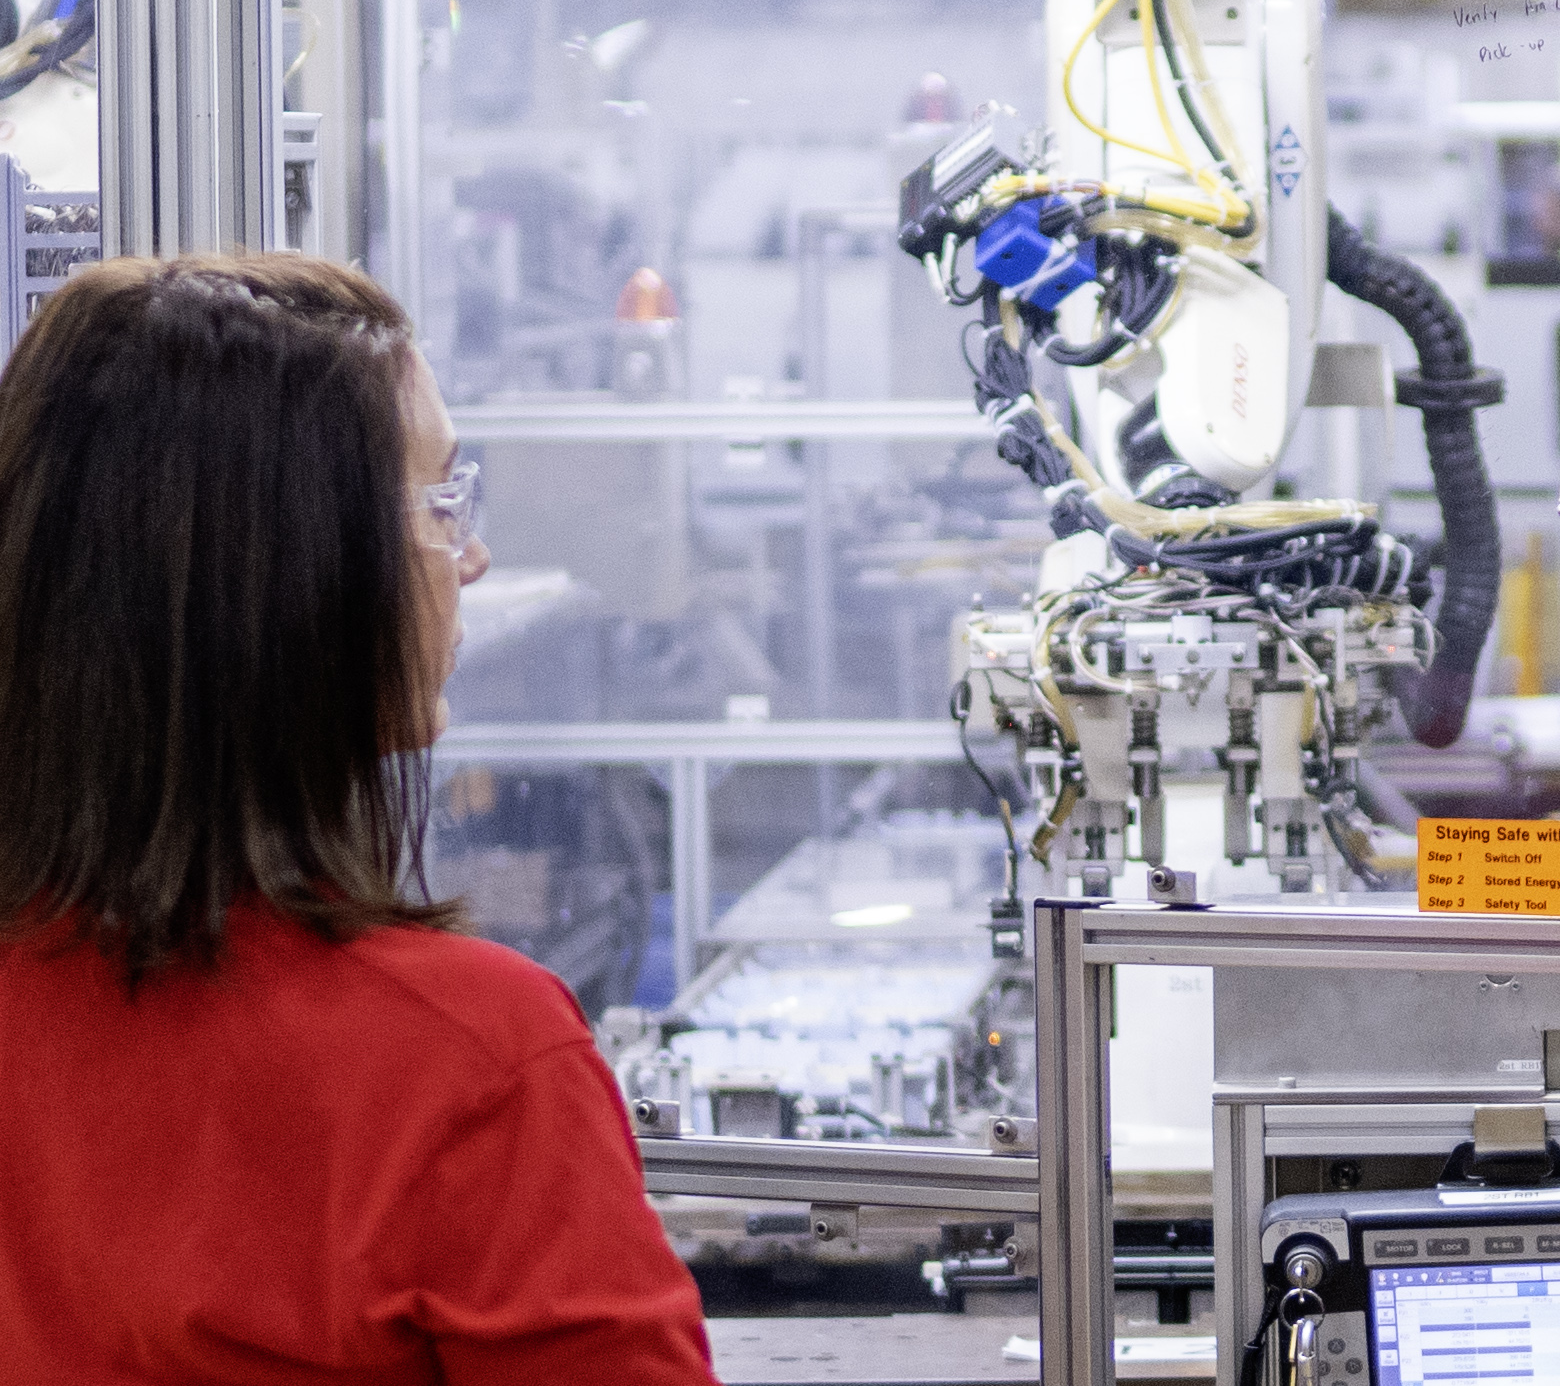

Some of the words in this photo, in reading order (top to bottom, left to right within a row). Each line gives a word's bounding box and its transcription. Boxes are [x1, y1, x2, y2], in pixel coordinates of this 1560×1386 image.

[1232, 342, 1248, 419] DENSO
[1436, 825, 1490, 843] Staying
[1497, 827, 1530, 841] Safe
[1428, 851, 1452, 862] Step
[1458, 853, 1462, 861] 1
[1485, 853, 1520, 863] Switch
[1525, 854, 1542, 863] Off
[1428, 875, 1452, 885] Step
[1457, 875, 1464, 885] 2
[1485, 875, 1520, 886] Stored
[1428, 897, 1453, 907] Step
[1457, 898, 1465, 907] 3
[1485, 899, 1520, 910] Safety
[1525, 900, 1547, 910] Tool
[1386, 1245, 1415, 1253] MOTOR
[1441, 1243, 1462, 1251] LOCK
